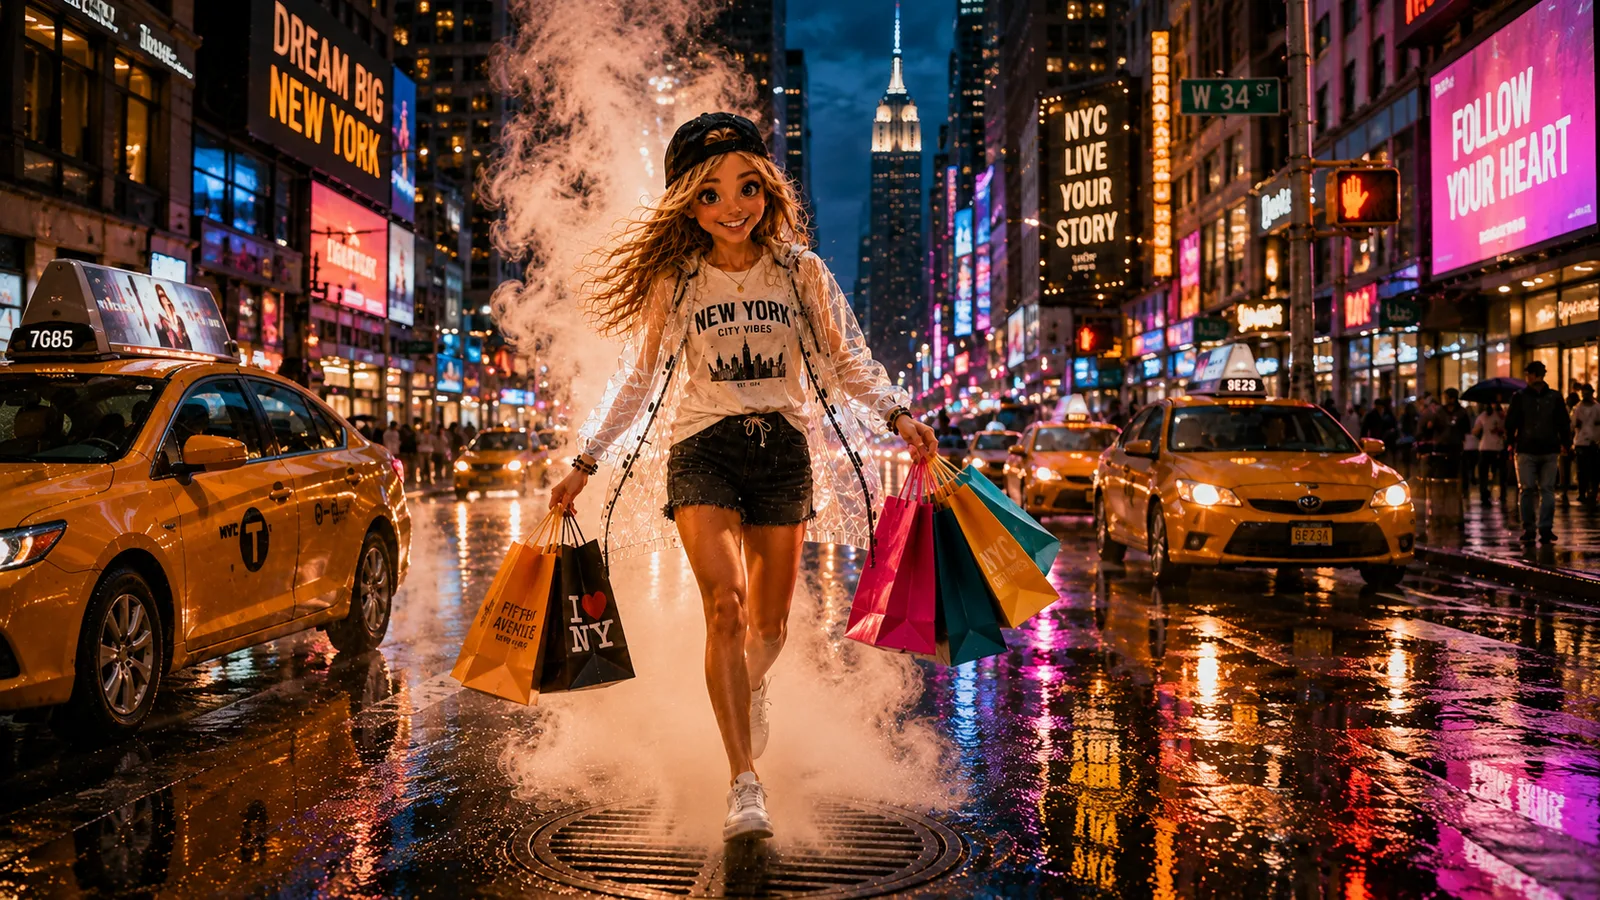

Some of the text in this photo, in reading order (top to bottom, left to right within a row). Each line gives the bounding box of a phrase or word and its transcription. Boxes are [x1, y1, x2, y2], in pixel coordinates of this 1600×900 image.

[273, 1, 349, 101] DREAM
[355, 63, 384, 124] BIG
[1192, 83, 1271, 110] W 34 ST
[1452, 66, 1533, 161] FOLLOW
[269, 65, 381, 179] NEW YORK
[1064, 104, 1108, 142] NYC
[1065, 141, 1107, 176] LIVE
[1446, 115, 1571, 220] YOUR HEART
[1060, 177, 1112, 212] YOUR
[1056, 212, 1118, 248] STORY
[694, 300, 791, 336] NEW YORK
[717, 324, 772, 338] CITY VIBES
[30, 330, 73, 349] 7G85
[246, 523, 262, 563] T
[978, 535, 1017, 575] NYC
[568, 595, 583, 623] I
[569, 619, 613, 652] NY
